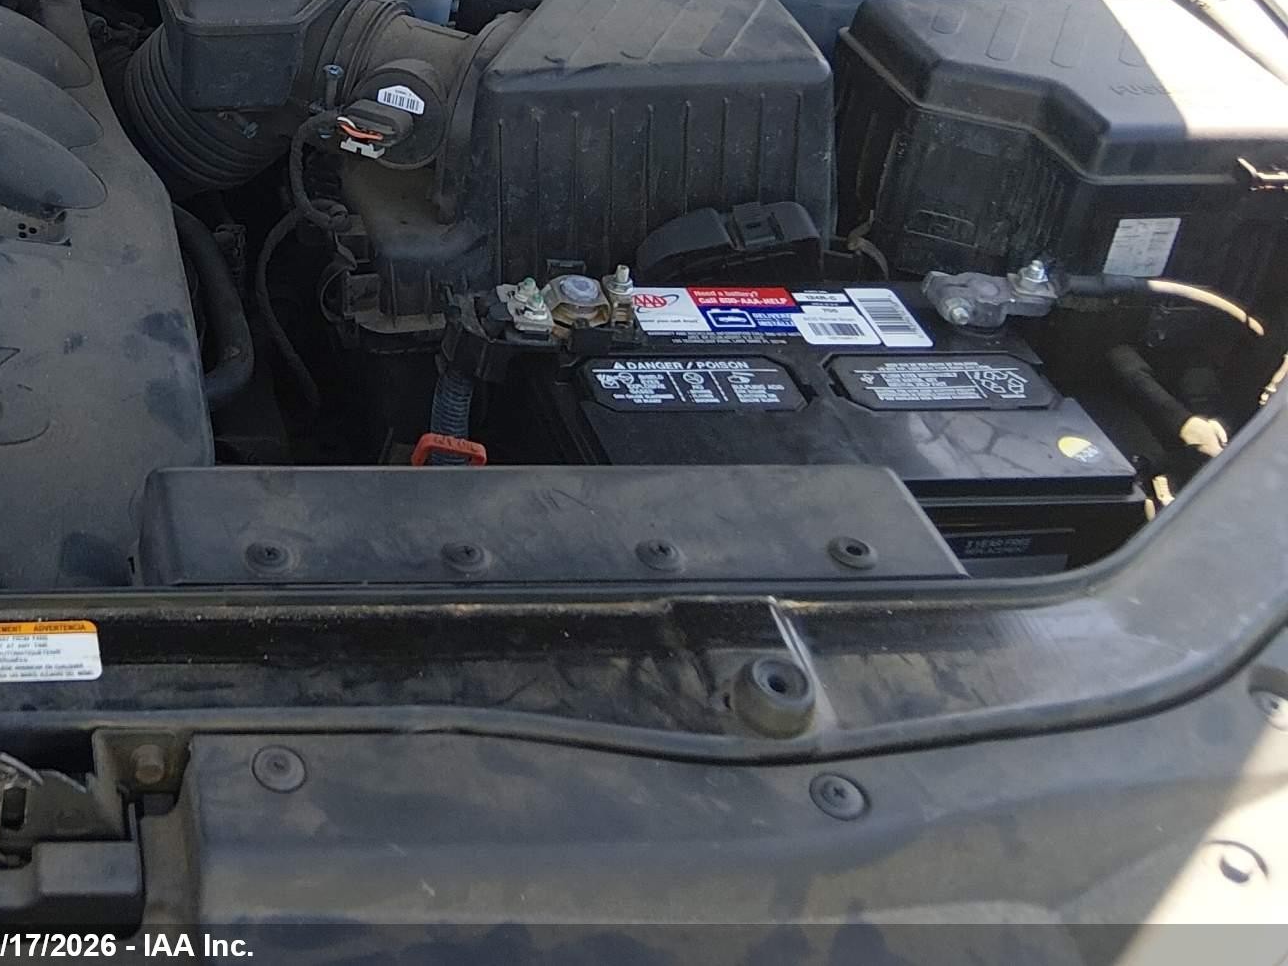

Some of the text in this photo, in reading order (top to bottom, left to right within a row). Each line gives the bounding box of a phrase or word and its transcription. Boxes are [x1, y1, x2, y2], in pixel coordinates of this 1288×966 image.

[634, 295, 665, 307] AAA
[625, 361, 684, 370] DANGER
[696, 361, 750, 369] POISON
[33, 624, 86, 632] ADVERTENCIA
